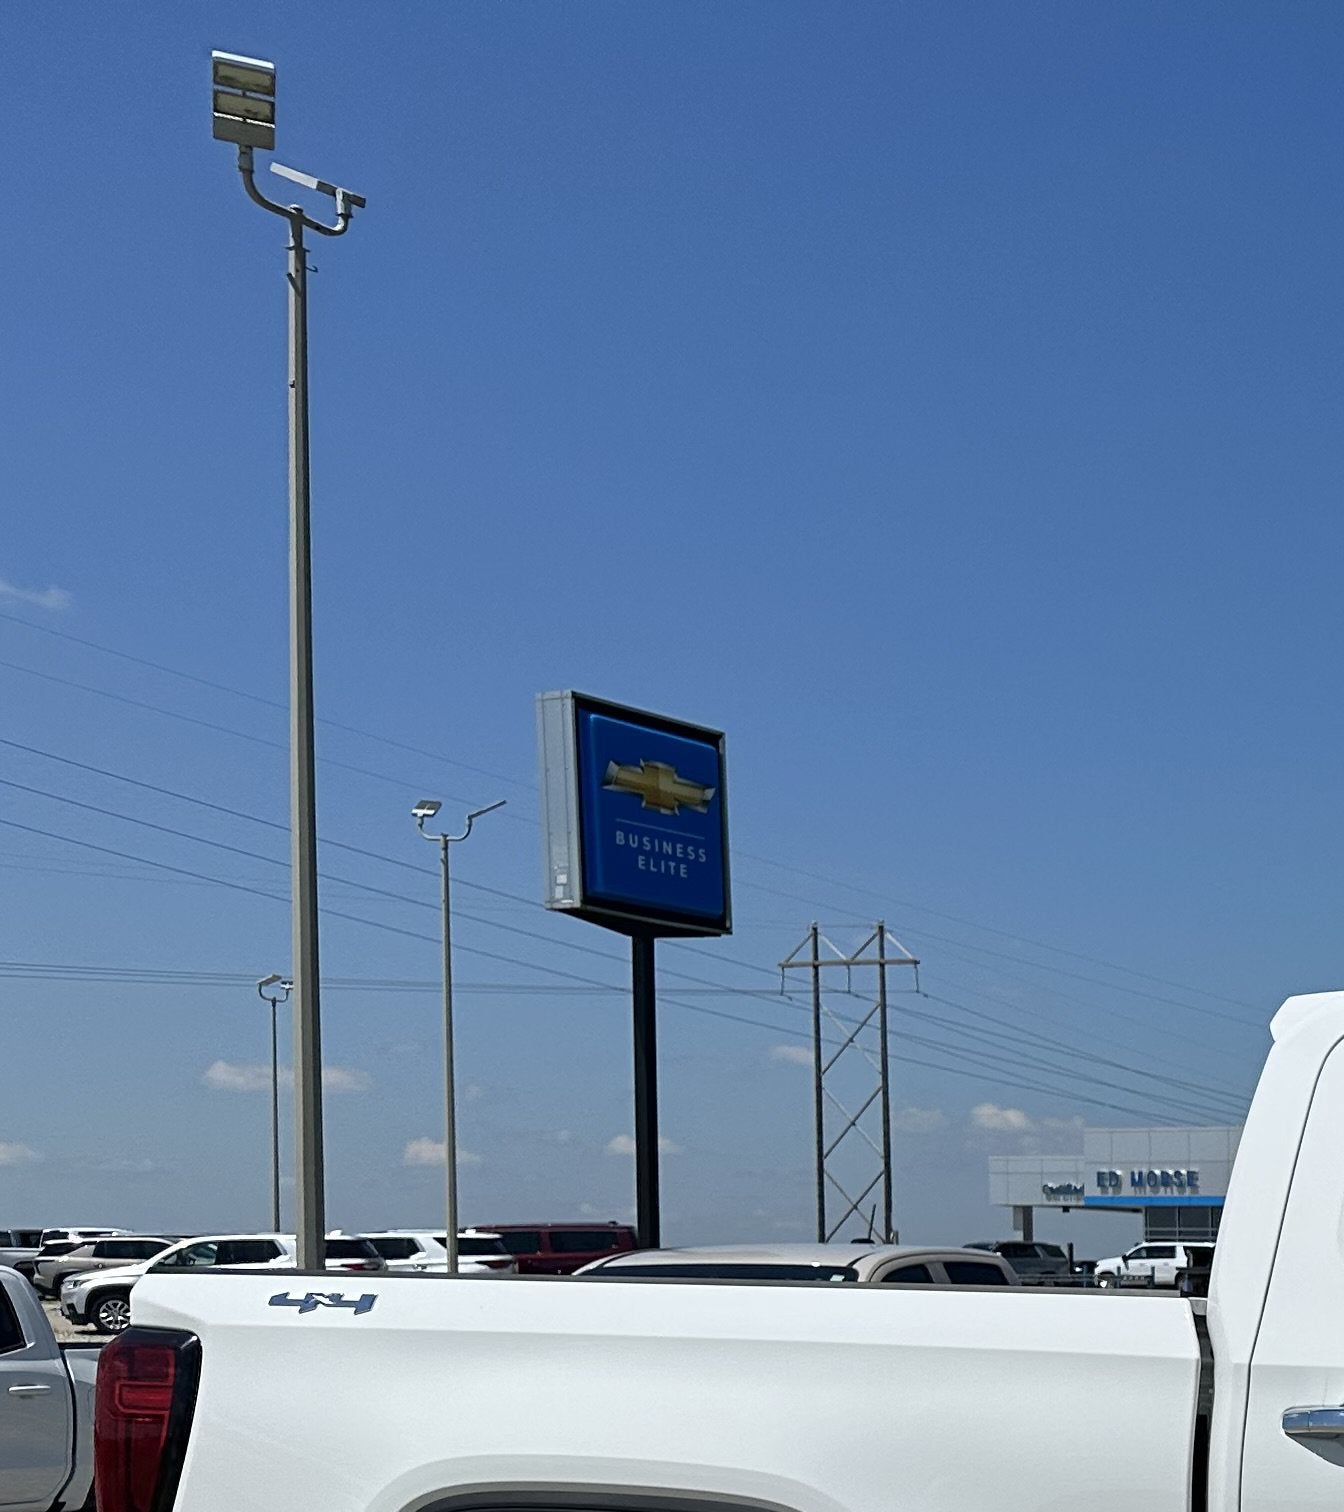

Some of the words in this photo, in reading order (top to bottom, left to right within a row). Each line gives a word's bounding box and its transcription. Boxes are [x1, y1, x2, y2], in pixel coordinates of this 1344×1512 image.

[616, 830, 707, 863] BUSINESS
[638, 855, 688, 878] ELITE
[1096, 1170, 1121, 1188] ED
[1130, 1170, 1200, 1188] MORSE
